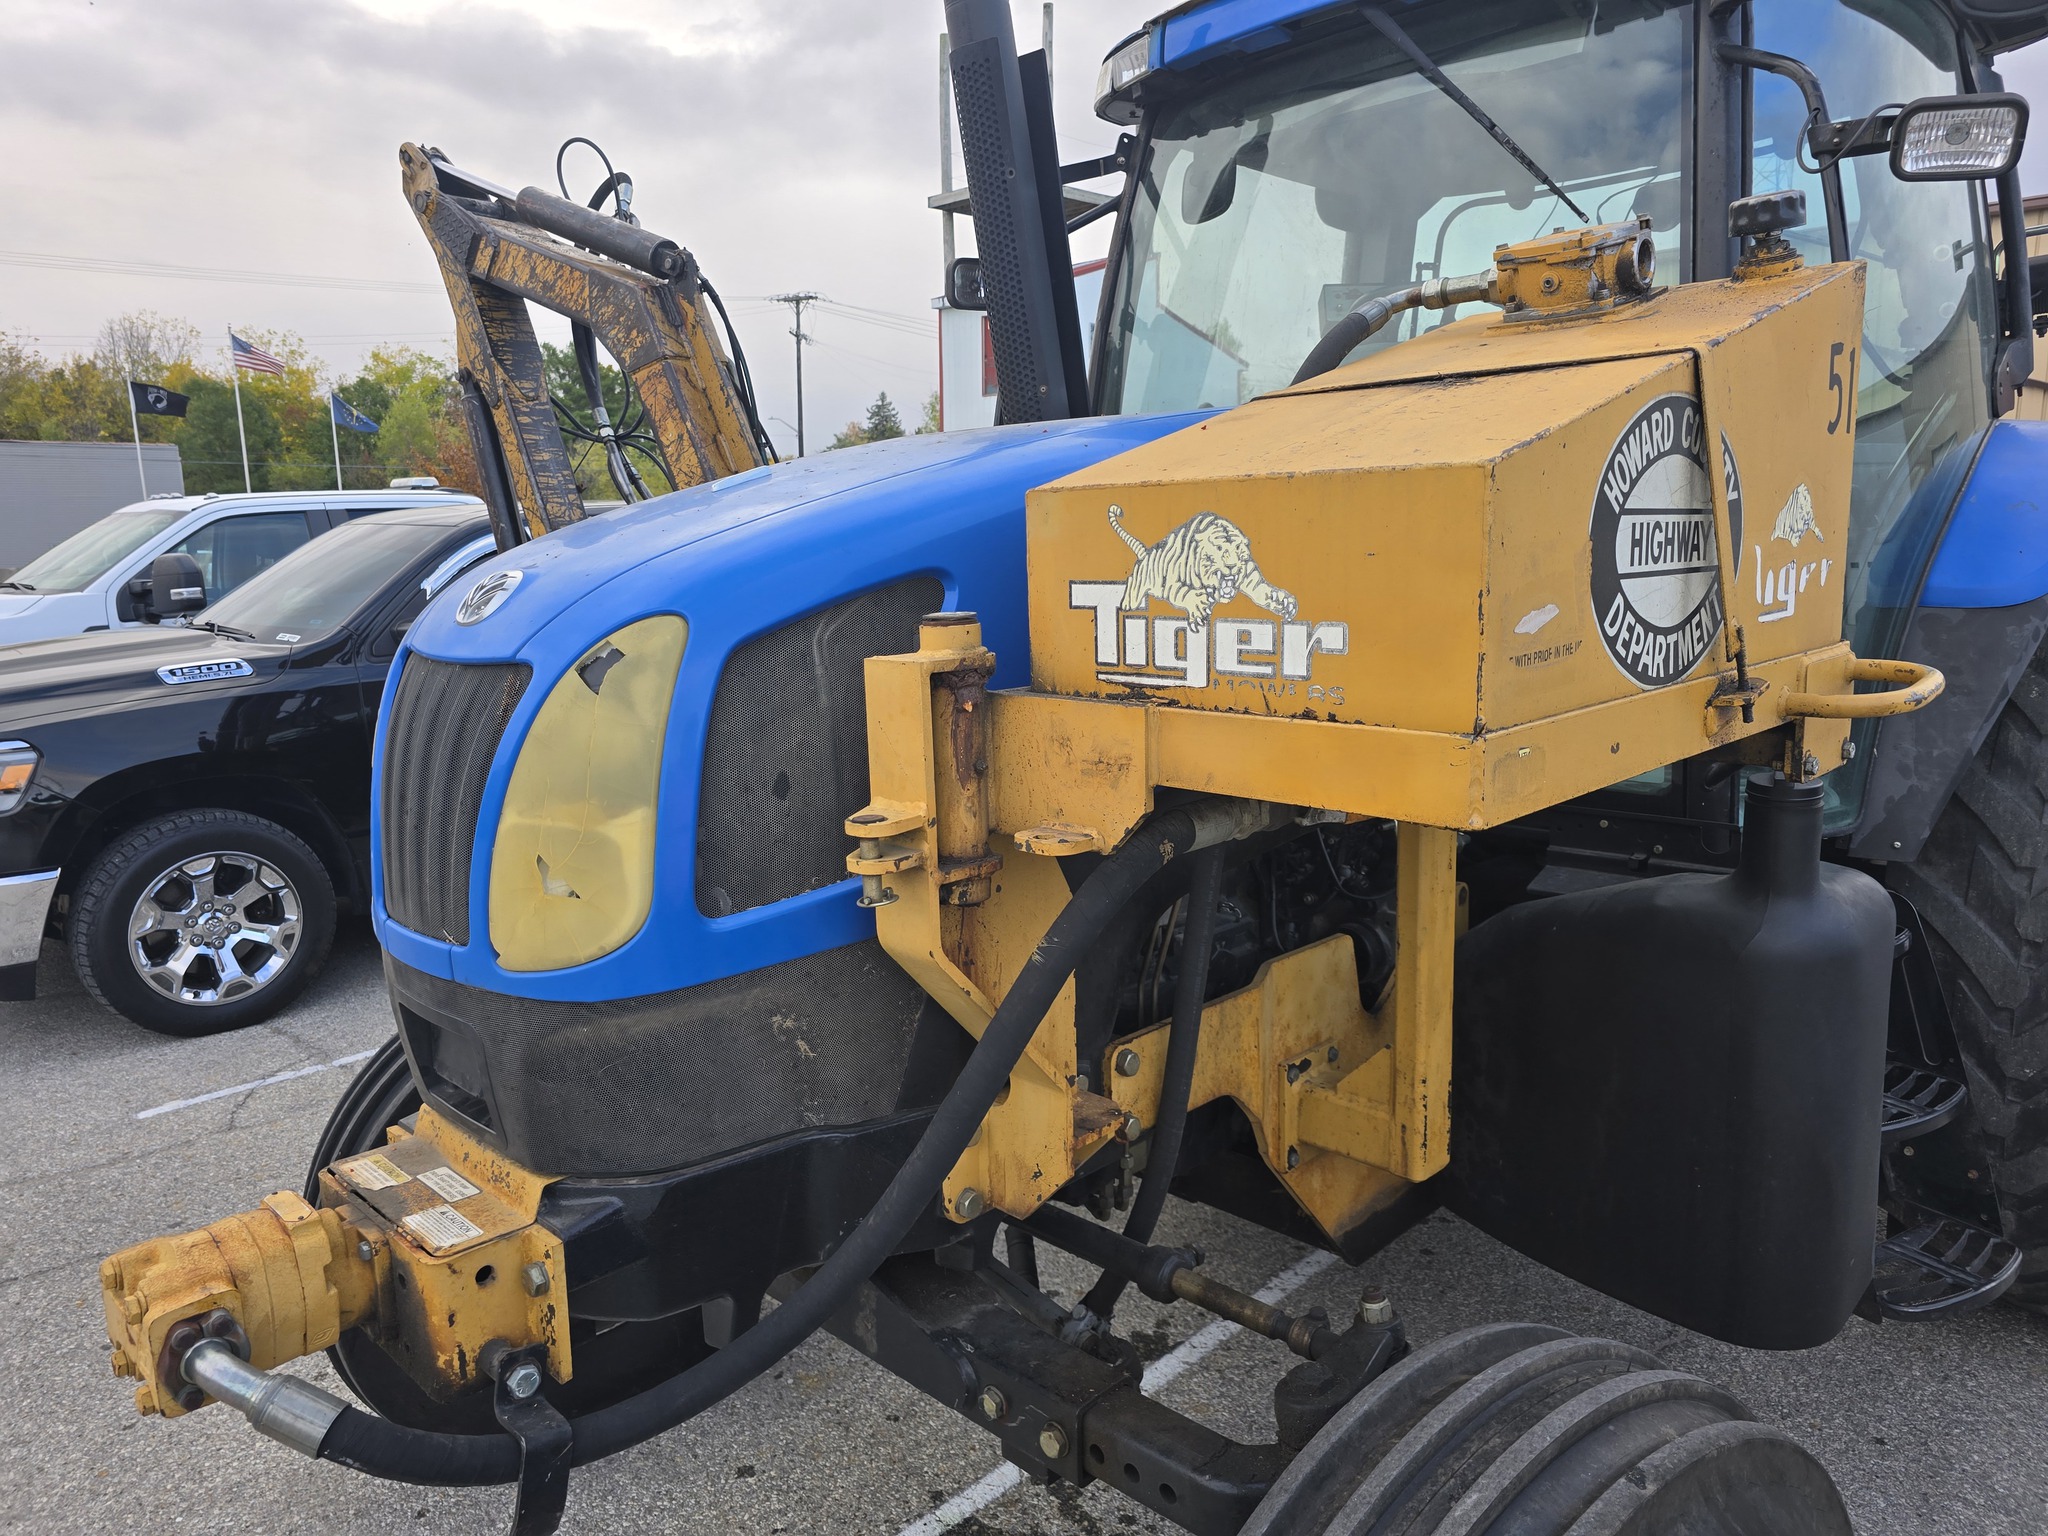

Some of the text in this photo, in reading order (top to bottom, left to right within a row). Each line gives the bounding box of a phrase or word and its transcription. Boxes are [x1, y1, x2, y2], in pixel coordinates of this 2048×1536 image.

[1827, 341, 1856, 435] 51
[1603, 406, 1674, 514] HOWARD
[1629, 519, 1713, 568] HIGHWAY
[1068, 579, 1349, 688] Tiger
[1514, 652, 1532, 668] WITH
[1553, 645, 1561, 659] IN
[1562, 642, 1574, 657] THE
[1603, 582, 1722, 678] DEPARTMENT
[172, 662, 238, 677] 1500
[445, 1213, 473, 1233] CAUTION
